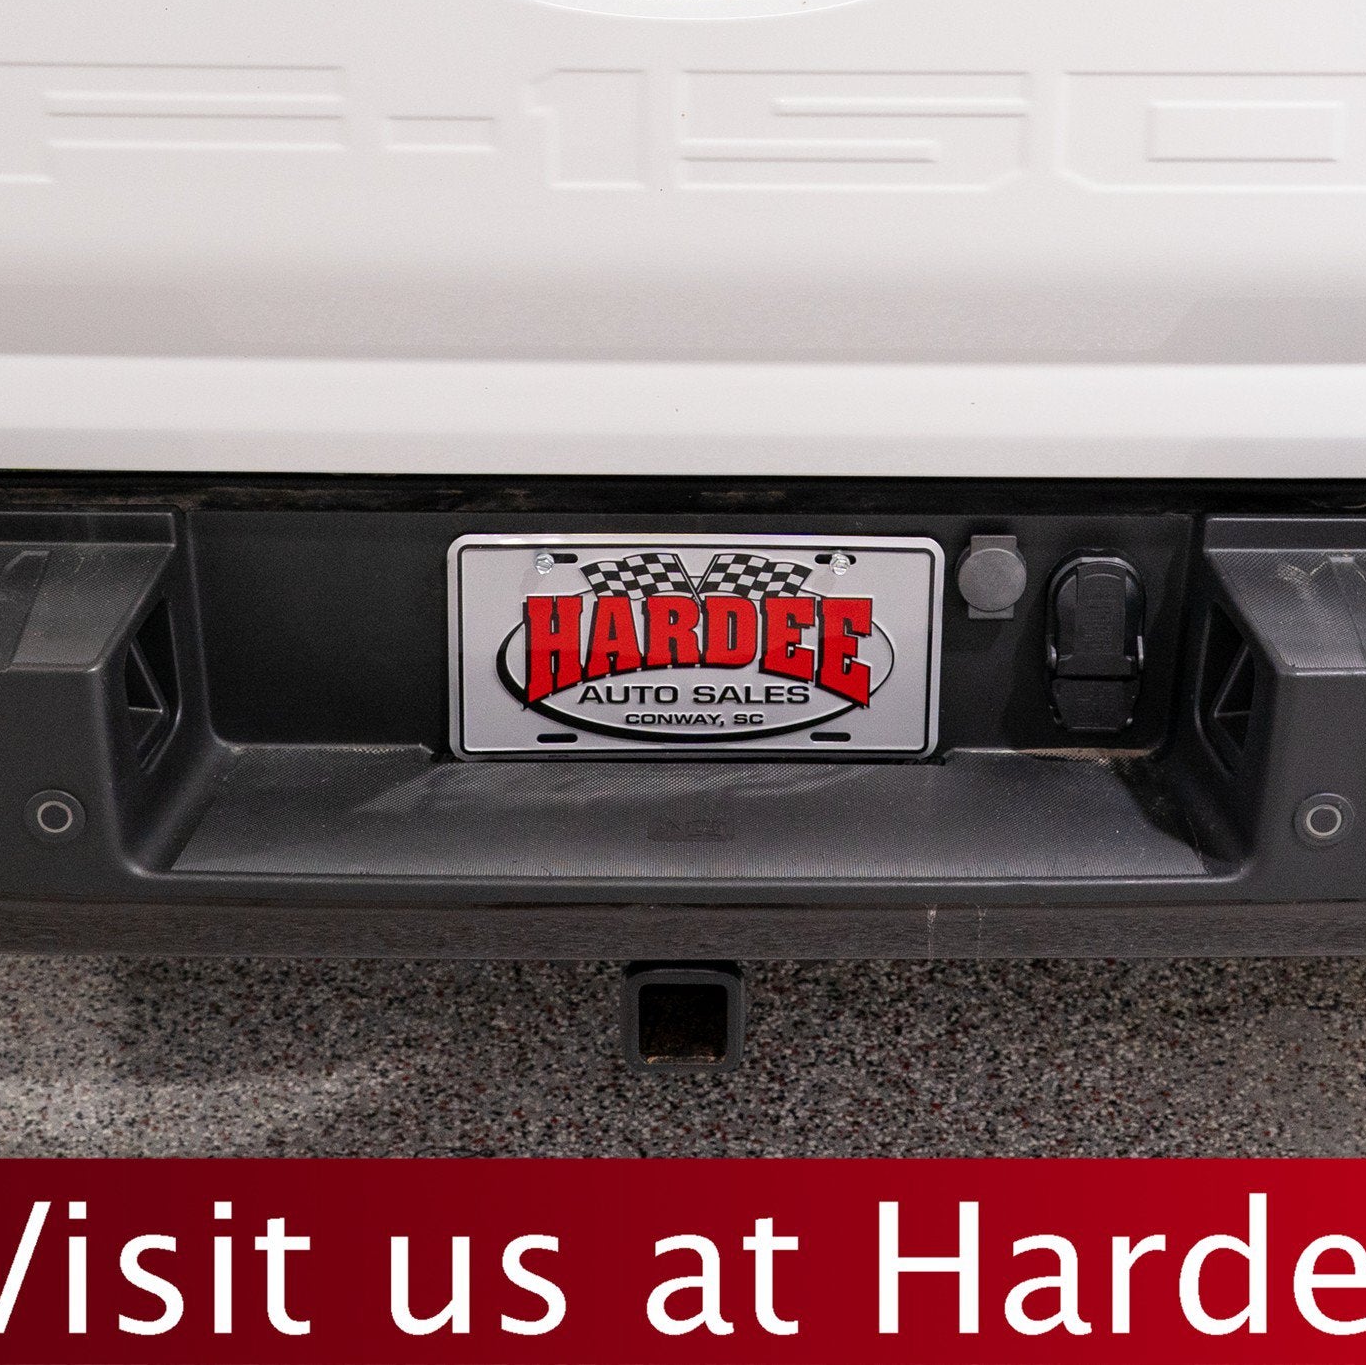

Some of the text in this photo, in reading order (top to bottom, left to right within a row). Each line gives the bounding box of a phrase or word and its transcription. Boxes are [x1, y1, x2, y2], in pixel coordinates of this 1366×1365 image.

[523, 595, 874, 711] HARDEE
[577, 684, 811, 706] AUTO SALES
[624, 712, 765, 728] CONWAY, SC
